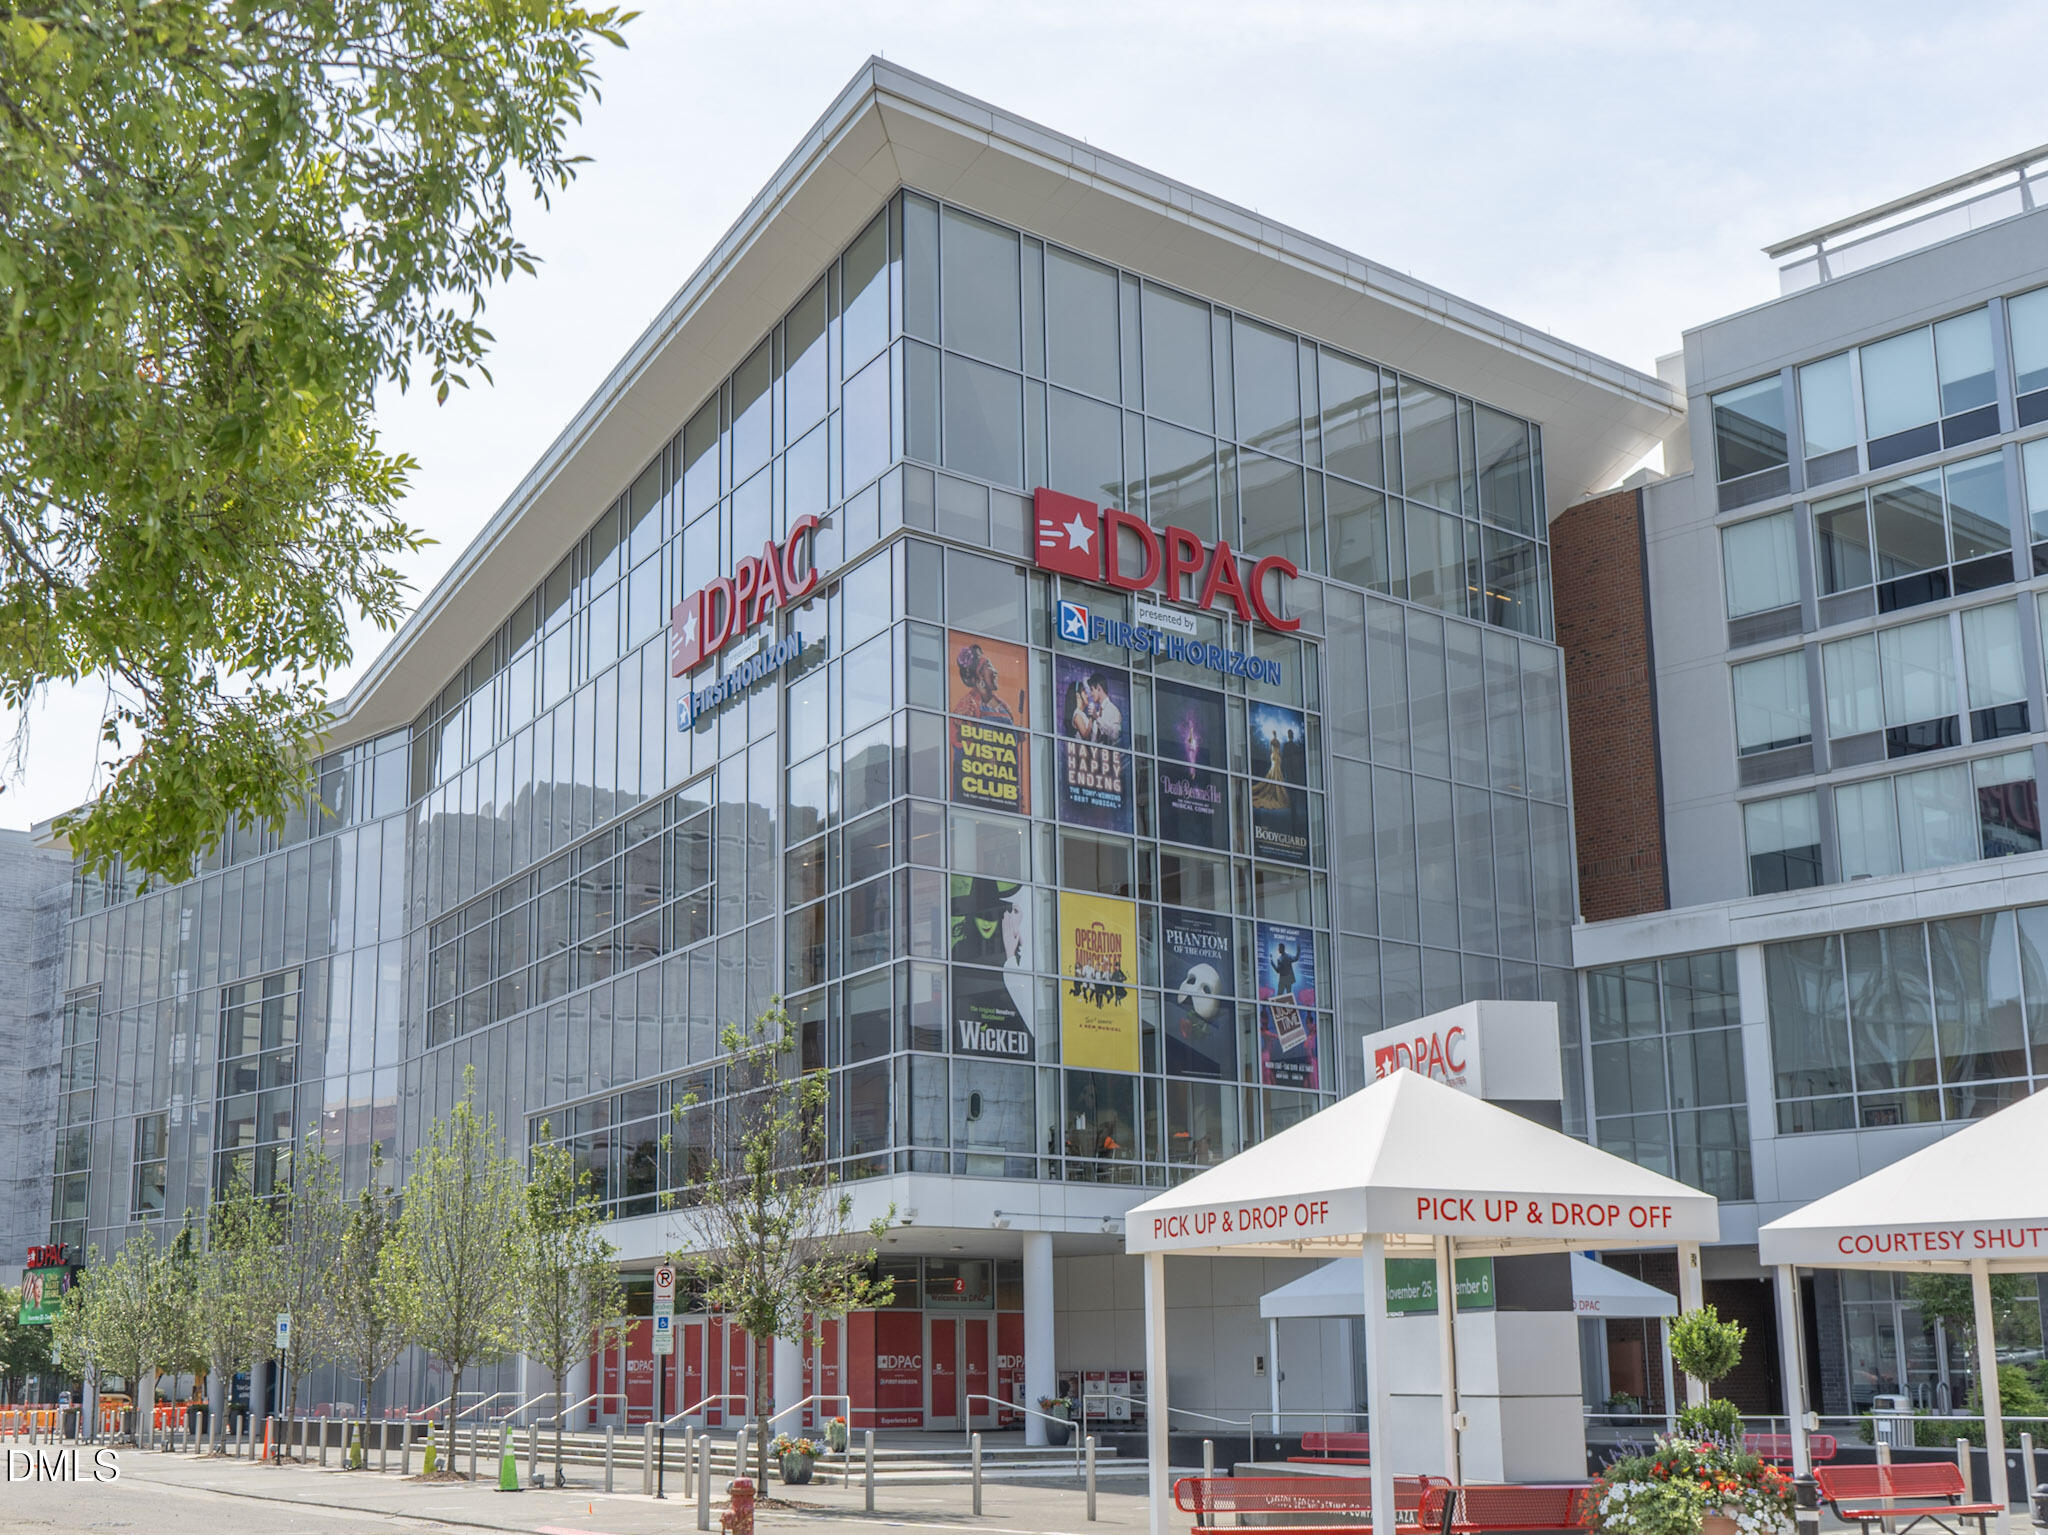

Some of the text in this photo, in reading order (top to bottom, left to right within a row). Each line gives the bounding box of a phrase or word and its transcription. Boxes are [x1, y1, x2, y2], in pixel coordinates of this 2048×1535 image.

[1104, 508, 1301, 632] DPAC
[704, 514, 818, 656] DPAC
[1139, 608, 1194, 630] presented by
[1090, 615, 1281, 687] FIRST HORIZON
[692, 674, 733, 719] FIRST
[731, 632, 802, 694] HORIZON
[961, 724, 1016, 747] BUENA
[962, 740, 1017, 765] VISTA
[1068, 742, 1120, 764] MAYBE
[962, 759, 1017, 782] SOCIAL
[1068, 756, 1120, 778] HAPPY
[962, 776, 1018, 800] CLUB
[1069, 770, 1121, 793] ENDING
[1255, 825, 1307, 848] BODYGUARD
[1075, 926, 1122, 953] OPERATION
[1166, 928, 1228, 952] PHANTOM
[1173, 944, 1221, 960] OF THE OPERA
[1394, 1025, 1467, 1078] DPAC
[1154, 1200, 1329, 1240] PICK UP & DROP OFF
[1417, 1197, 1672, 1228] PICK UP & DROP OFF
[1838, 1230, 1965, 1254] COURTESY
[36, 1243, 68, 1268] DPAC
[1387, 1283, 1421, 1300] ovember
[1421, 1280, 1433, 1298] 25
[1456, 1277, 1480, 1295] ember
[1482, 1274, 1489, 1294] 6
[1579, 1300, 1600, 1311] DPAC
[633, 1360, 654, 1372] DPAC
[888, 1355, 922, 1369] DPAC
